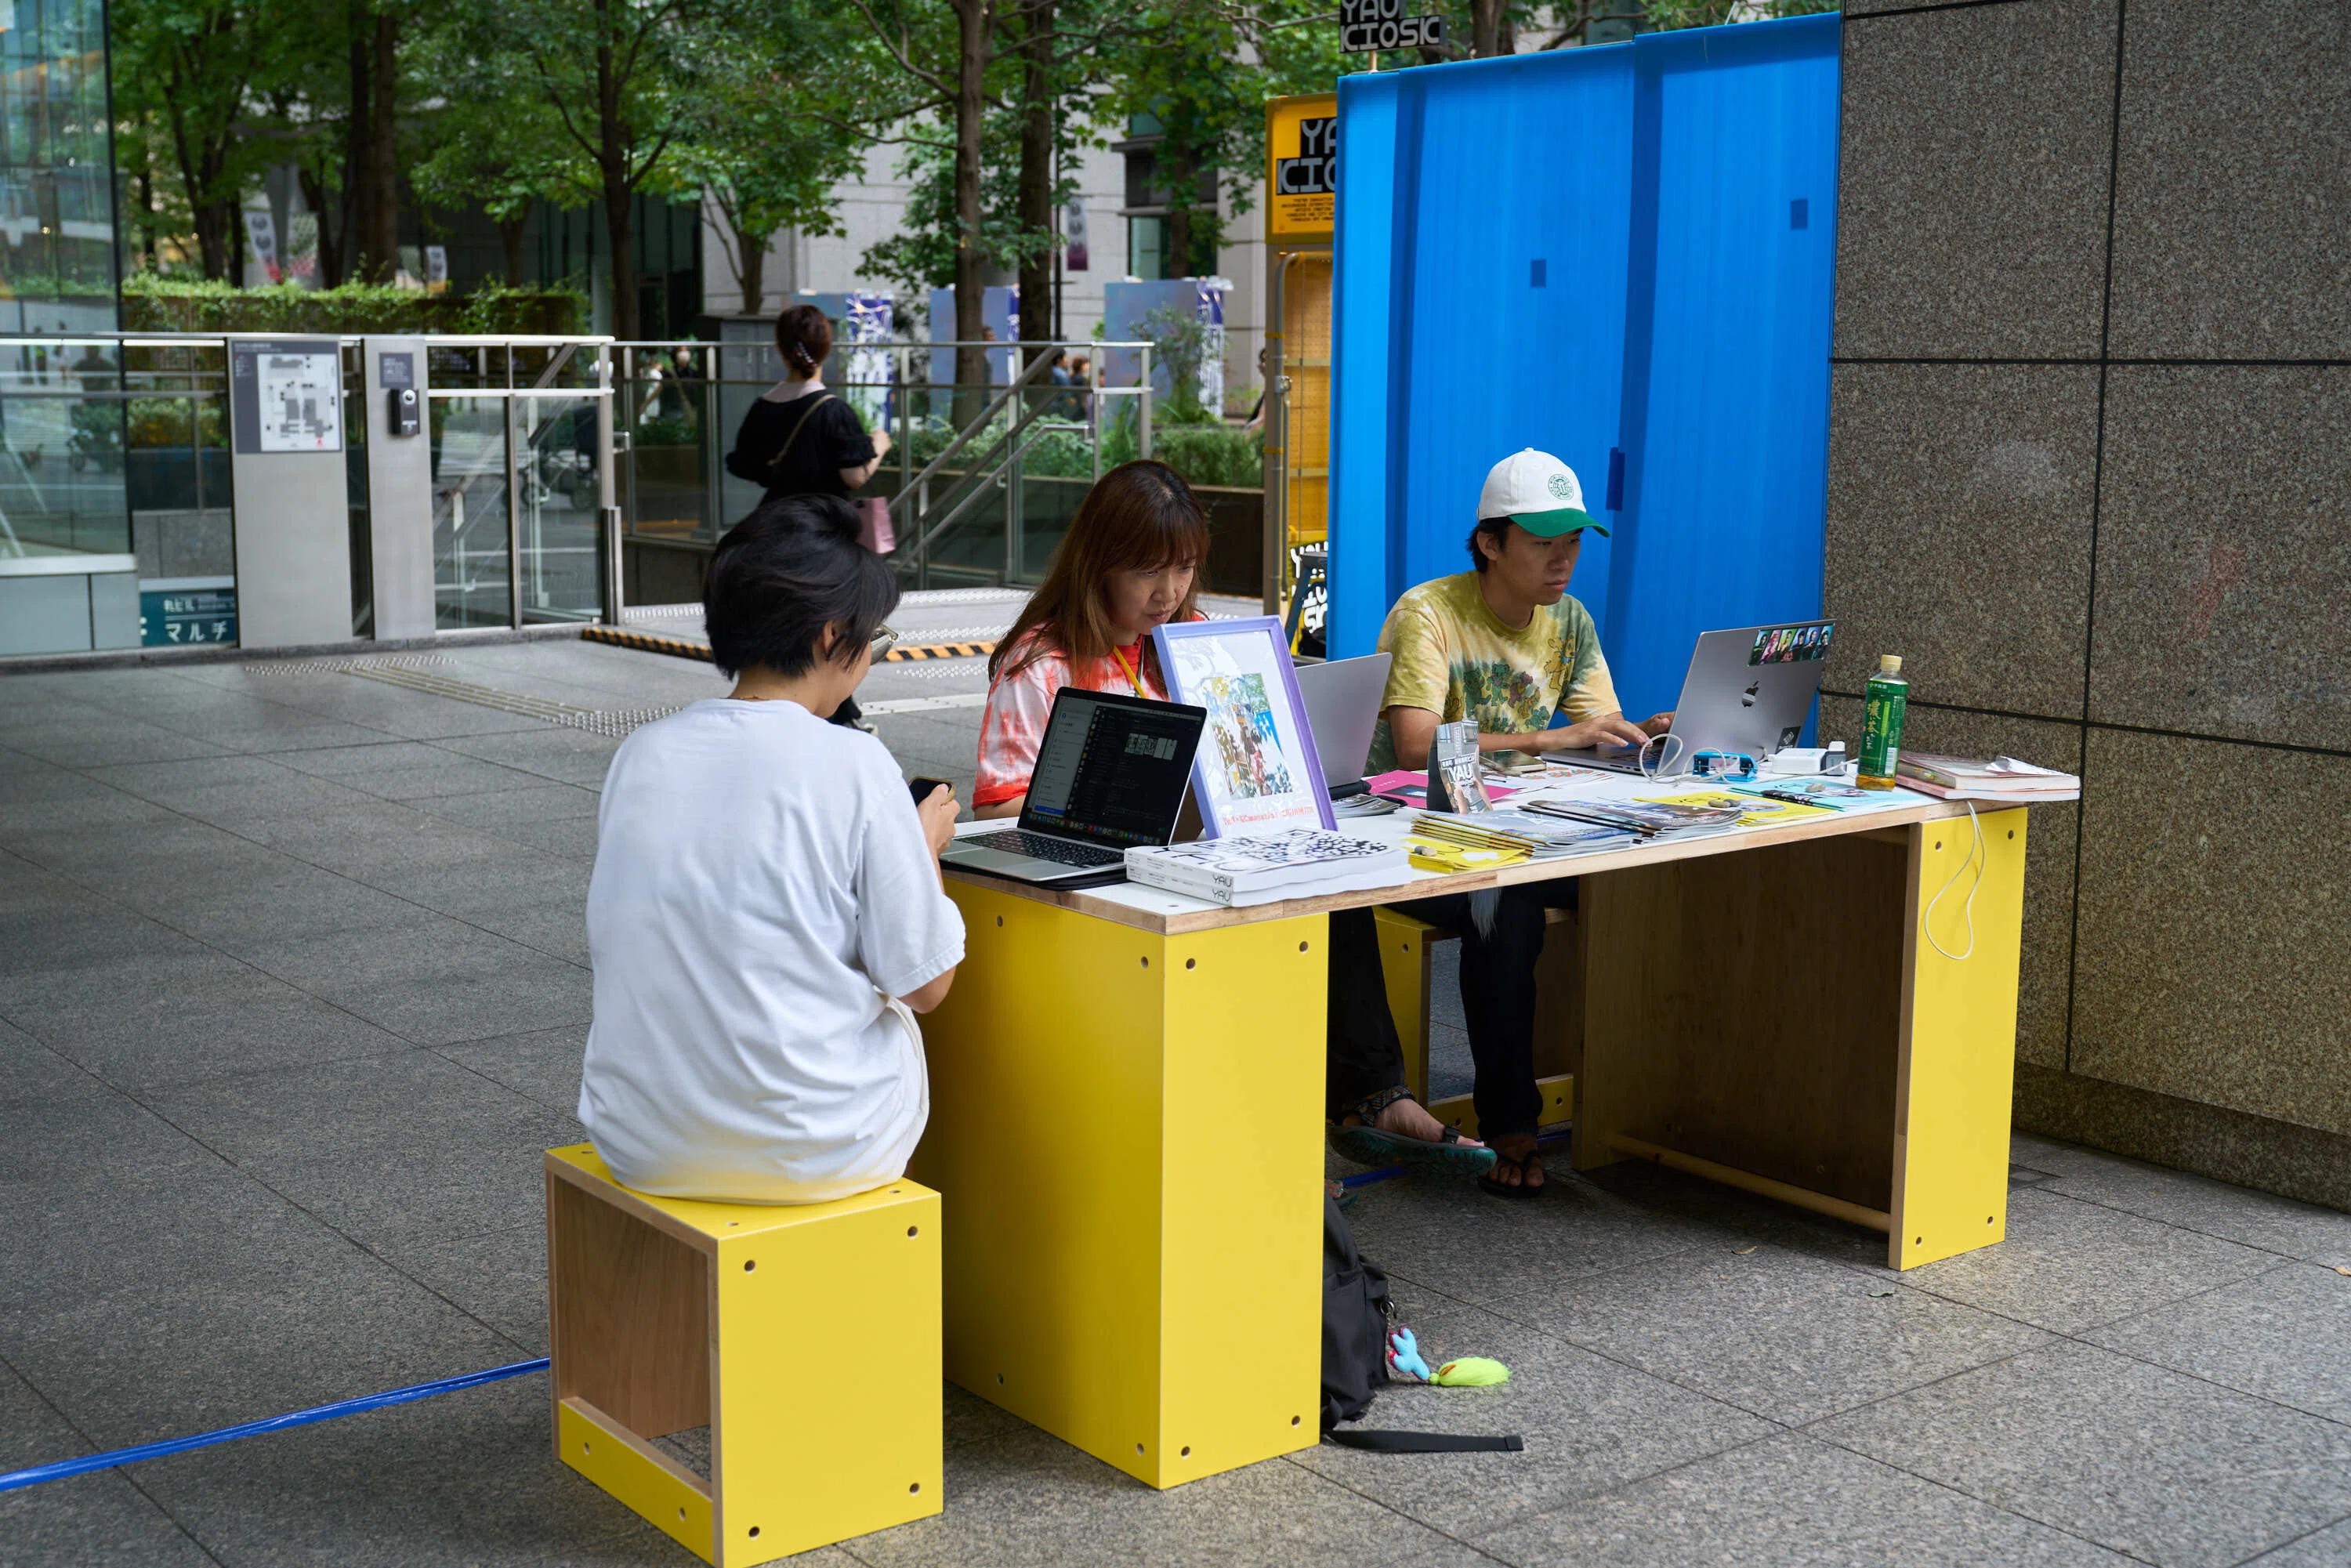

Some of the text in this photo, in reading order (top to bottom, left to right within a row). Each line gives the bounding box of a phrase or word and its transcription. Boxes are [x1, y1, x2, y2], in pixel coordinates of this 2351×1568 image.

[1341, 0, 1400, 23] YAU
[1341, 17, 1440, 52] KIOSK
[1302, 118, 1337, 155] YA
[1277, 157, 1335, 194] KIO
[1448, 763, 1473, 782] YAU
[1212, 875, 1232, 888] YAU
[1212, 889, 1231, 902] YAU
